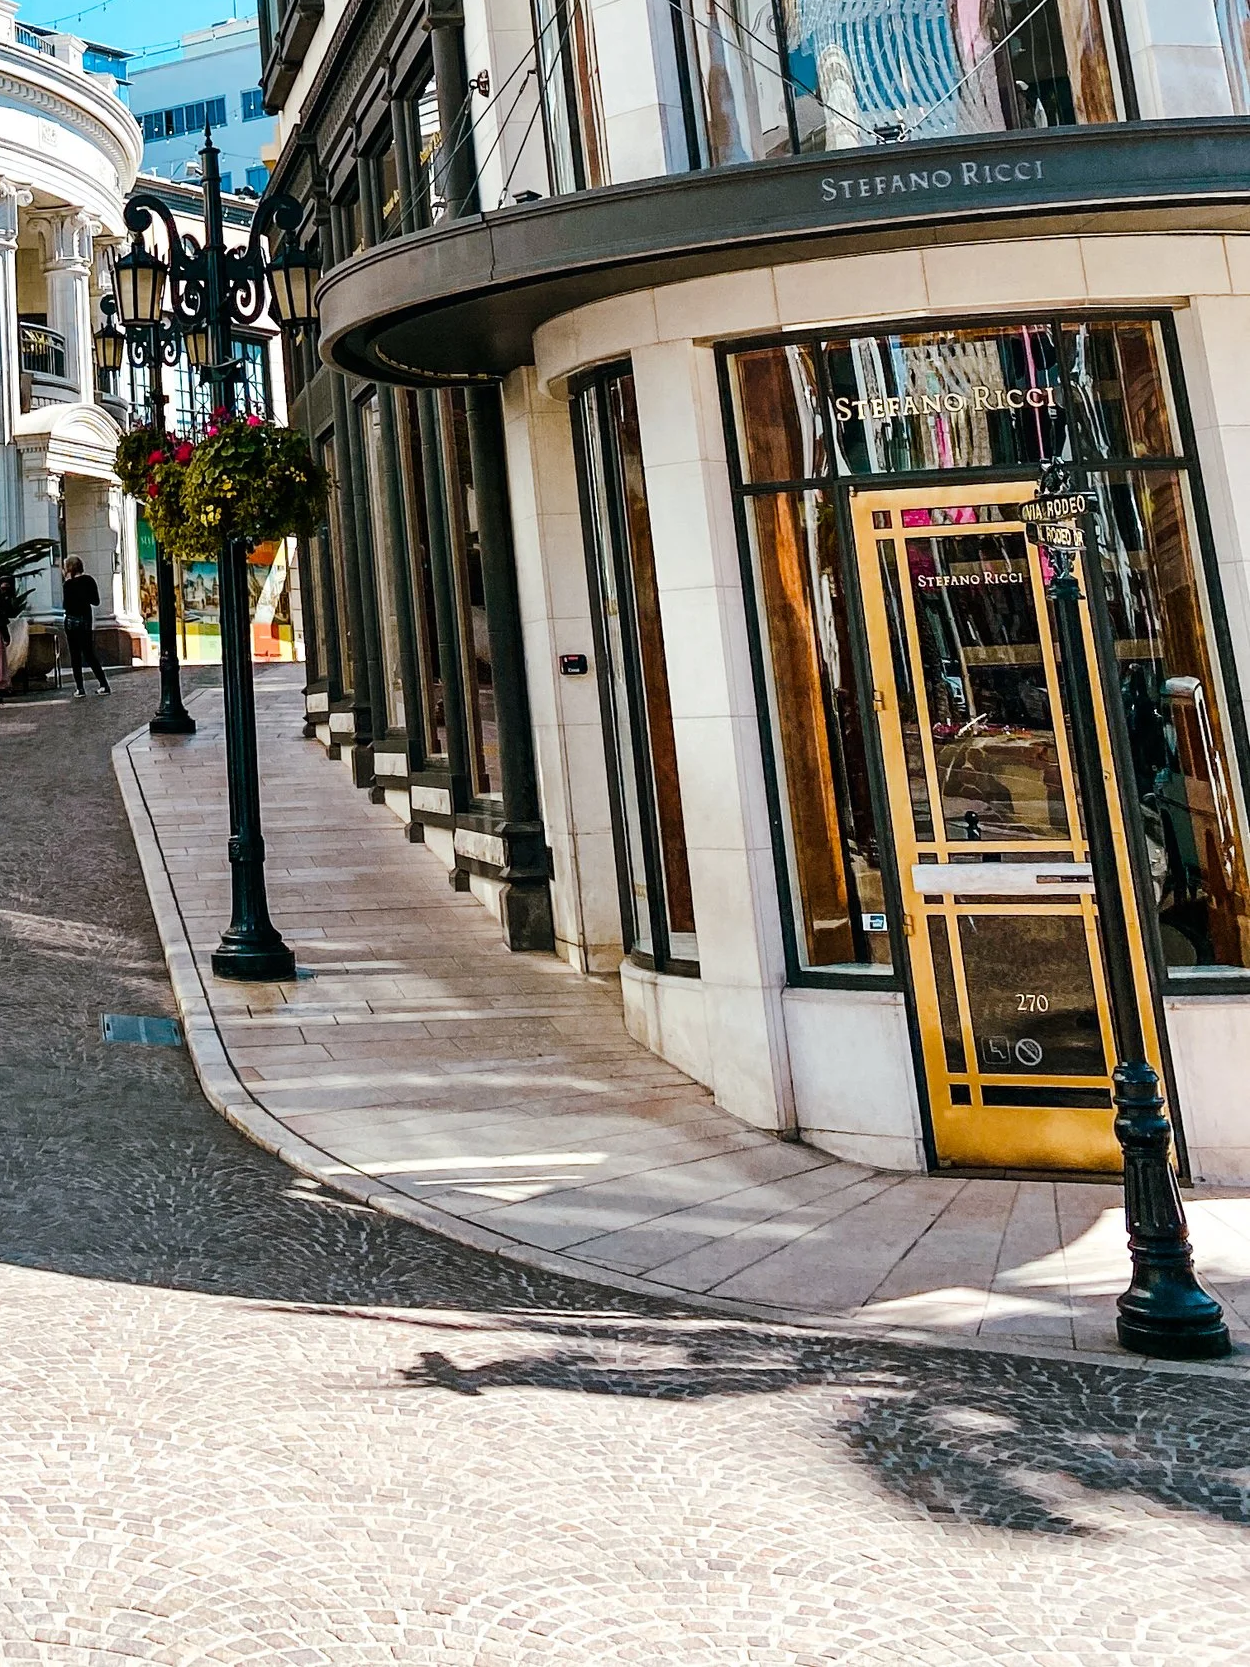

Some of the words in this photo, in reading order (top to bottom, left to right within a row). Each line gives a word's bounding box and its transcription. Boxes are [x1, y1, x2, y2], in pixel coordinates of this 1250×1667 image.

[821, 169, 952, 202] STEFANO
[960, 160, 1045, 186] RICCI
[834, 392, 967, 422] STEFANO
[971, 385, 1057, 412] RICCI
[1022, 502, 1043, 521] VIA
[1047, 495, 1085, 517] RODEO
[917, 574, 980, 588] STEFANO
[983, 571, 1024, 585] RICCI
[1015, 994, 1049, 1013] 270
